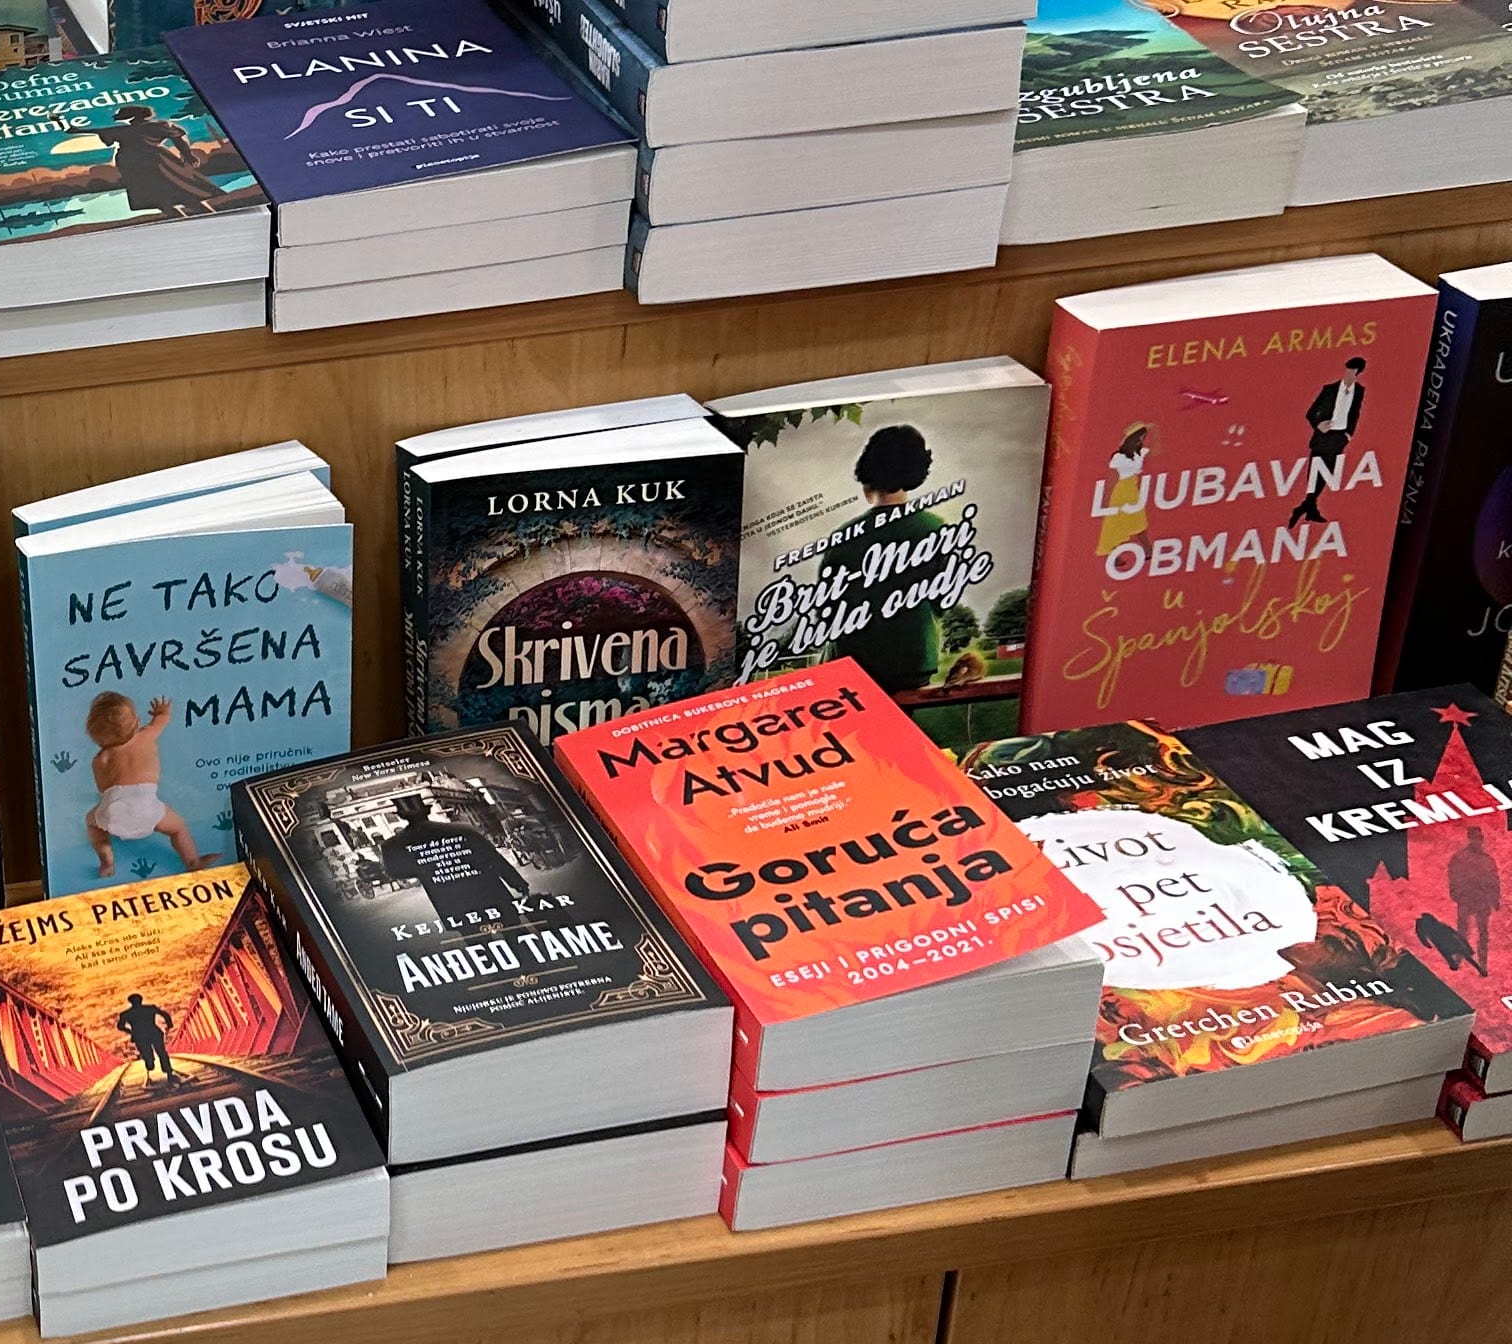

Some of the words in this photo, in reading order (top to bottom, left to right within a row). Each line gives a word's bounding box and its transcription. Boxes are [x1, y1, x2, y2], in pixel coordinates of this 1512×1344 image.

[267, 28, 351, 50] Brianna
[353, 23, 415, 39] Wiest
[1228, 4, 1387, 36] Olujna
[1237, 13, 1435, 61] SESTRA
[232, 39, 493, 84] PLANINA
[344, 105, 393, 128] SI
[407, 97, 462, 118] TI
[1018, 84, 1219, 124] SESTRA
[1147, 337, 1248, 369] ELENA
[1263, 321, 1379, 355] ARMAS
[487, 488, 602, 516] LORNA
[616, 480, 686, 504] KUK
[1090, 451, 1383, 518] LJUBAVNA
[774, 522, 867, 571] FREDRIK
[873, 479, 967, 529] BAKMAN
[746, 505, 978, 633] Brit-Mari
[1104, 521, 1348, 581] OBMANA
[1163, 588, 1185, 610] u
[61, 623, 321, 689] SAVRŠENA
[476, 621, 688, 690] Skrivena
[184, 680, 333, 728] MAMA
[196, 758, 220, 768] Ovo
[226, 754, 250, 765] nije
[256, 746, 313, 761] priručnik
[596, 687, 866, 779] Margaret
[1287, 720, 1417, 760] MAG
[683, 731, 857, 806] Atvud
[1356, 758, 1426, 791] IZ
[684, 802, 986, 902] Goruća
[91, 879, 236, 926] PATERSON
[390, 908, 501, 941] KEJLEB
[512, 894, 574, 914] KAR
[730, 846, 1014, 961] pitanja
[770, 962, 832, 989] ESEJI
[841, 955, 849, 969] I
[856, 920, 977, 966] PRIGODNI
[985, 895, 1046, 926] SPISI
[1118, 1001, 1279, 1047] Gretchen
[1280, 975, 1393, 1011] Rubin
[79, 1089, 292, 1169] PRAVDA
[63, 1172, 140, 1225] PO
[152, 1122, 339, 1202] KROSU
